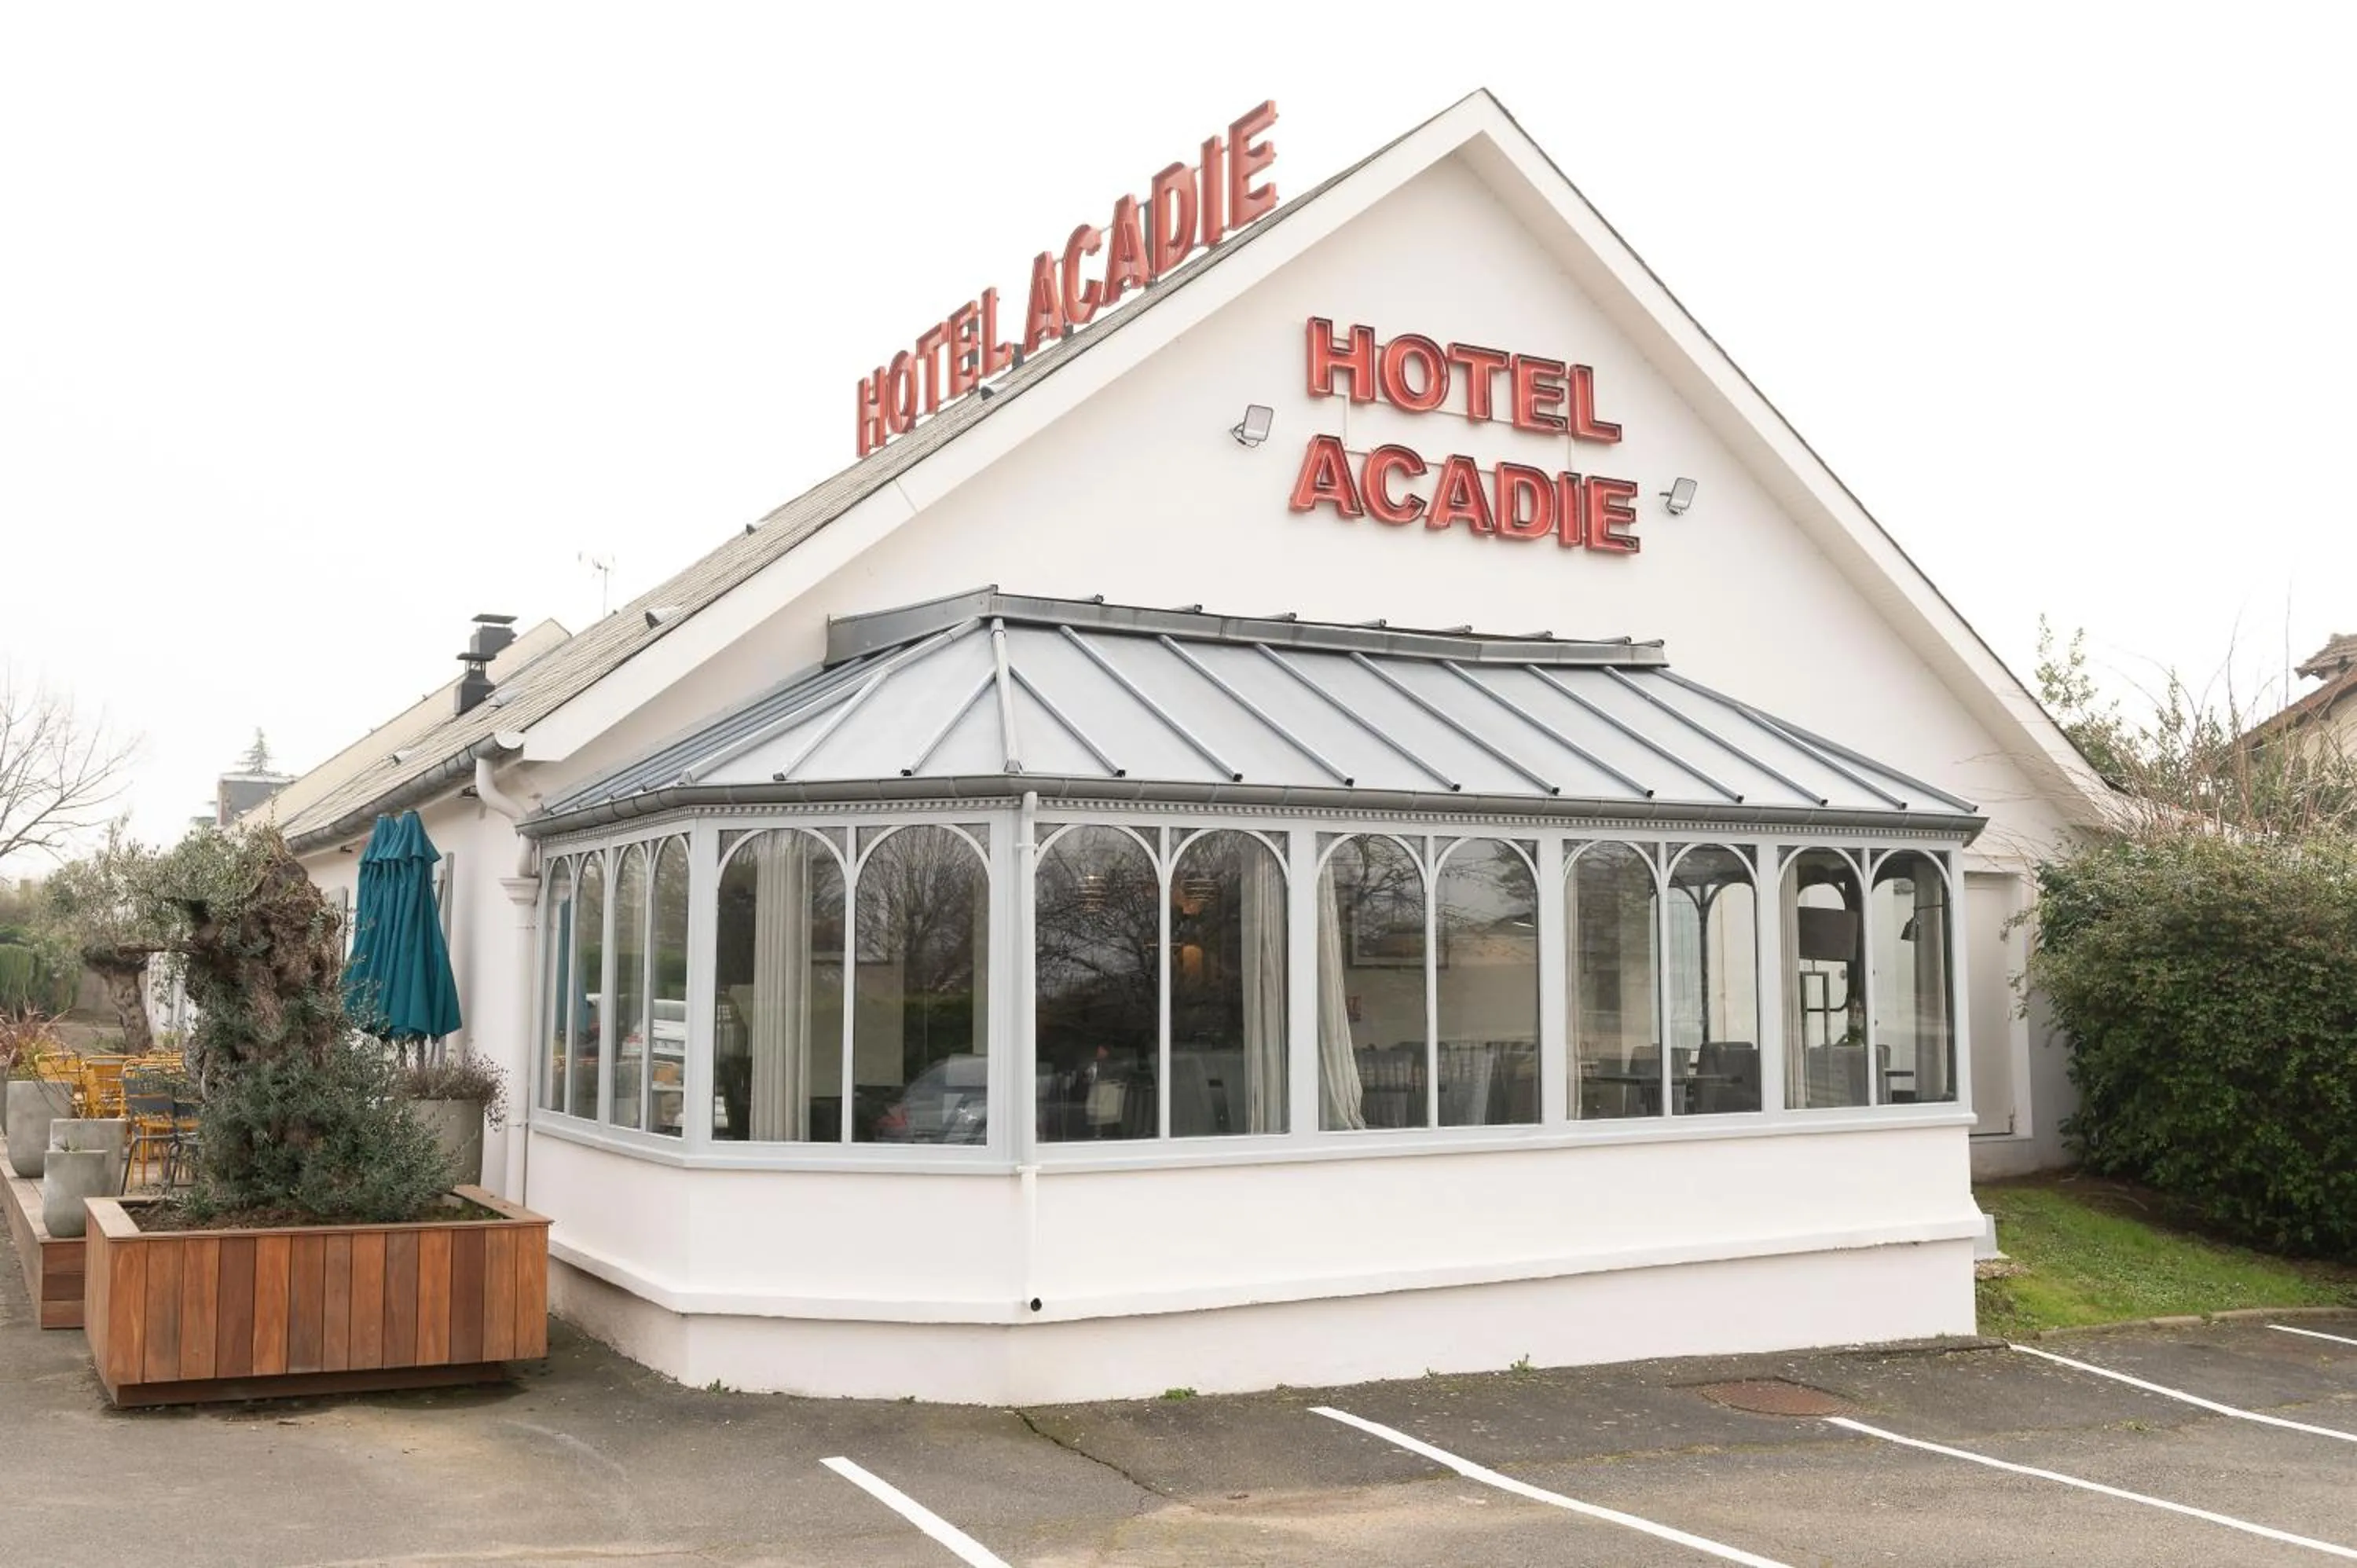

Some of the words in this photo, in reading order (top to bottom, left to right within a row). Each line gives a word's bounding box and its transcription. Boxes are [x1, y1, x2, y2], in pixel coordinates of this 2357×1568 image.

[856, 287, 1012, 459] HOTEL
[1024, 100, 1278, 356] ACADIE
[1307, 316, 1622, 444] HOTEL
[1289, 434, 1640, 553] ACADIE
